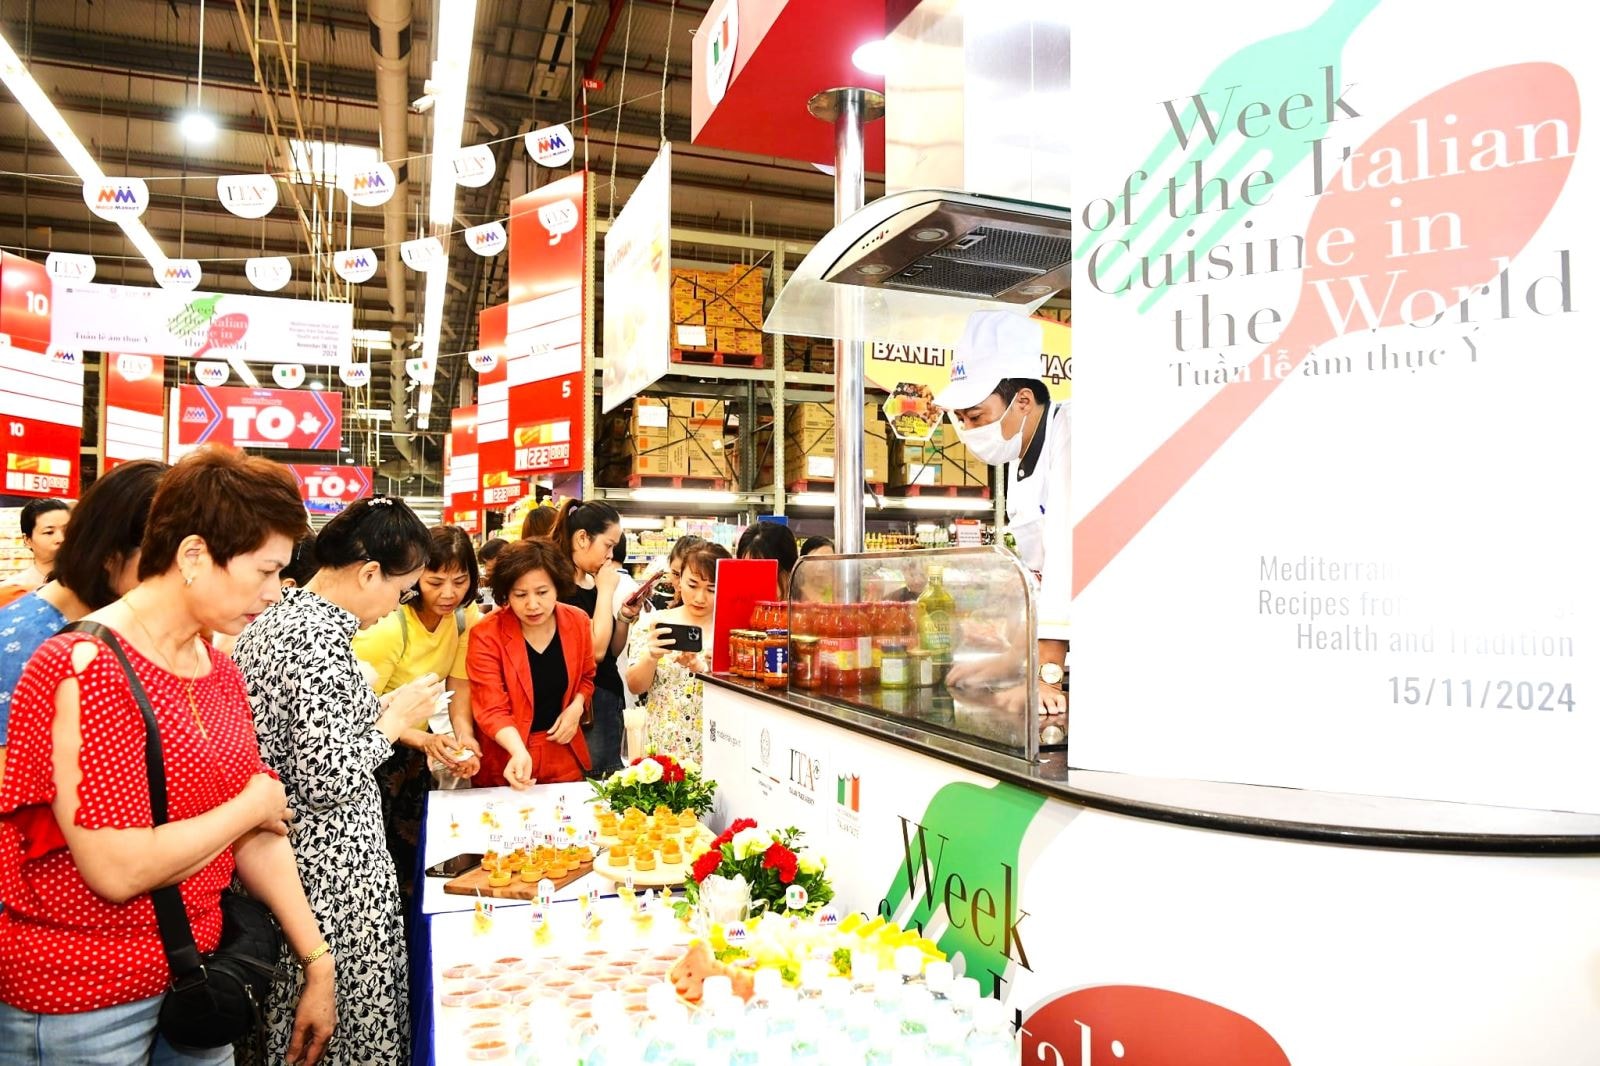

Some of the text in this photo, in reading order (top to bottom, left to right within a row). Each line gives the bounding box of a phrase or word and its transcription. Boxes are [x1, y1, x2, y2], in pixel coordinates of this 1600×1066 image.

[1157, 66, 1361, 150] Week
[1082, 114, 1577, 231] of the Italian
[1088, 197, 1469, 294] Cuisine in
[26, 290, 49, 317] 10
[1171, 250, 1579, 352] the World
[1168, 353, 1250, 387] Tuần
[1263, 348, 1293, 382] lễ
[562, 381, 571, 399] 5
[9, 421, 25, 438] 10
[227, 405, 296, 440] TO
[304, 476, 346, 497] TO
[1258, 589, 1351, 621] Recipes
[1296, 623, 1379, 651] Health
[1389, 624, 1435, 653] and
[1388, 676, 1577, 712] 15/11/2024
[897, 815, 1034, 973] Week
